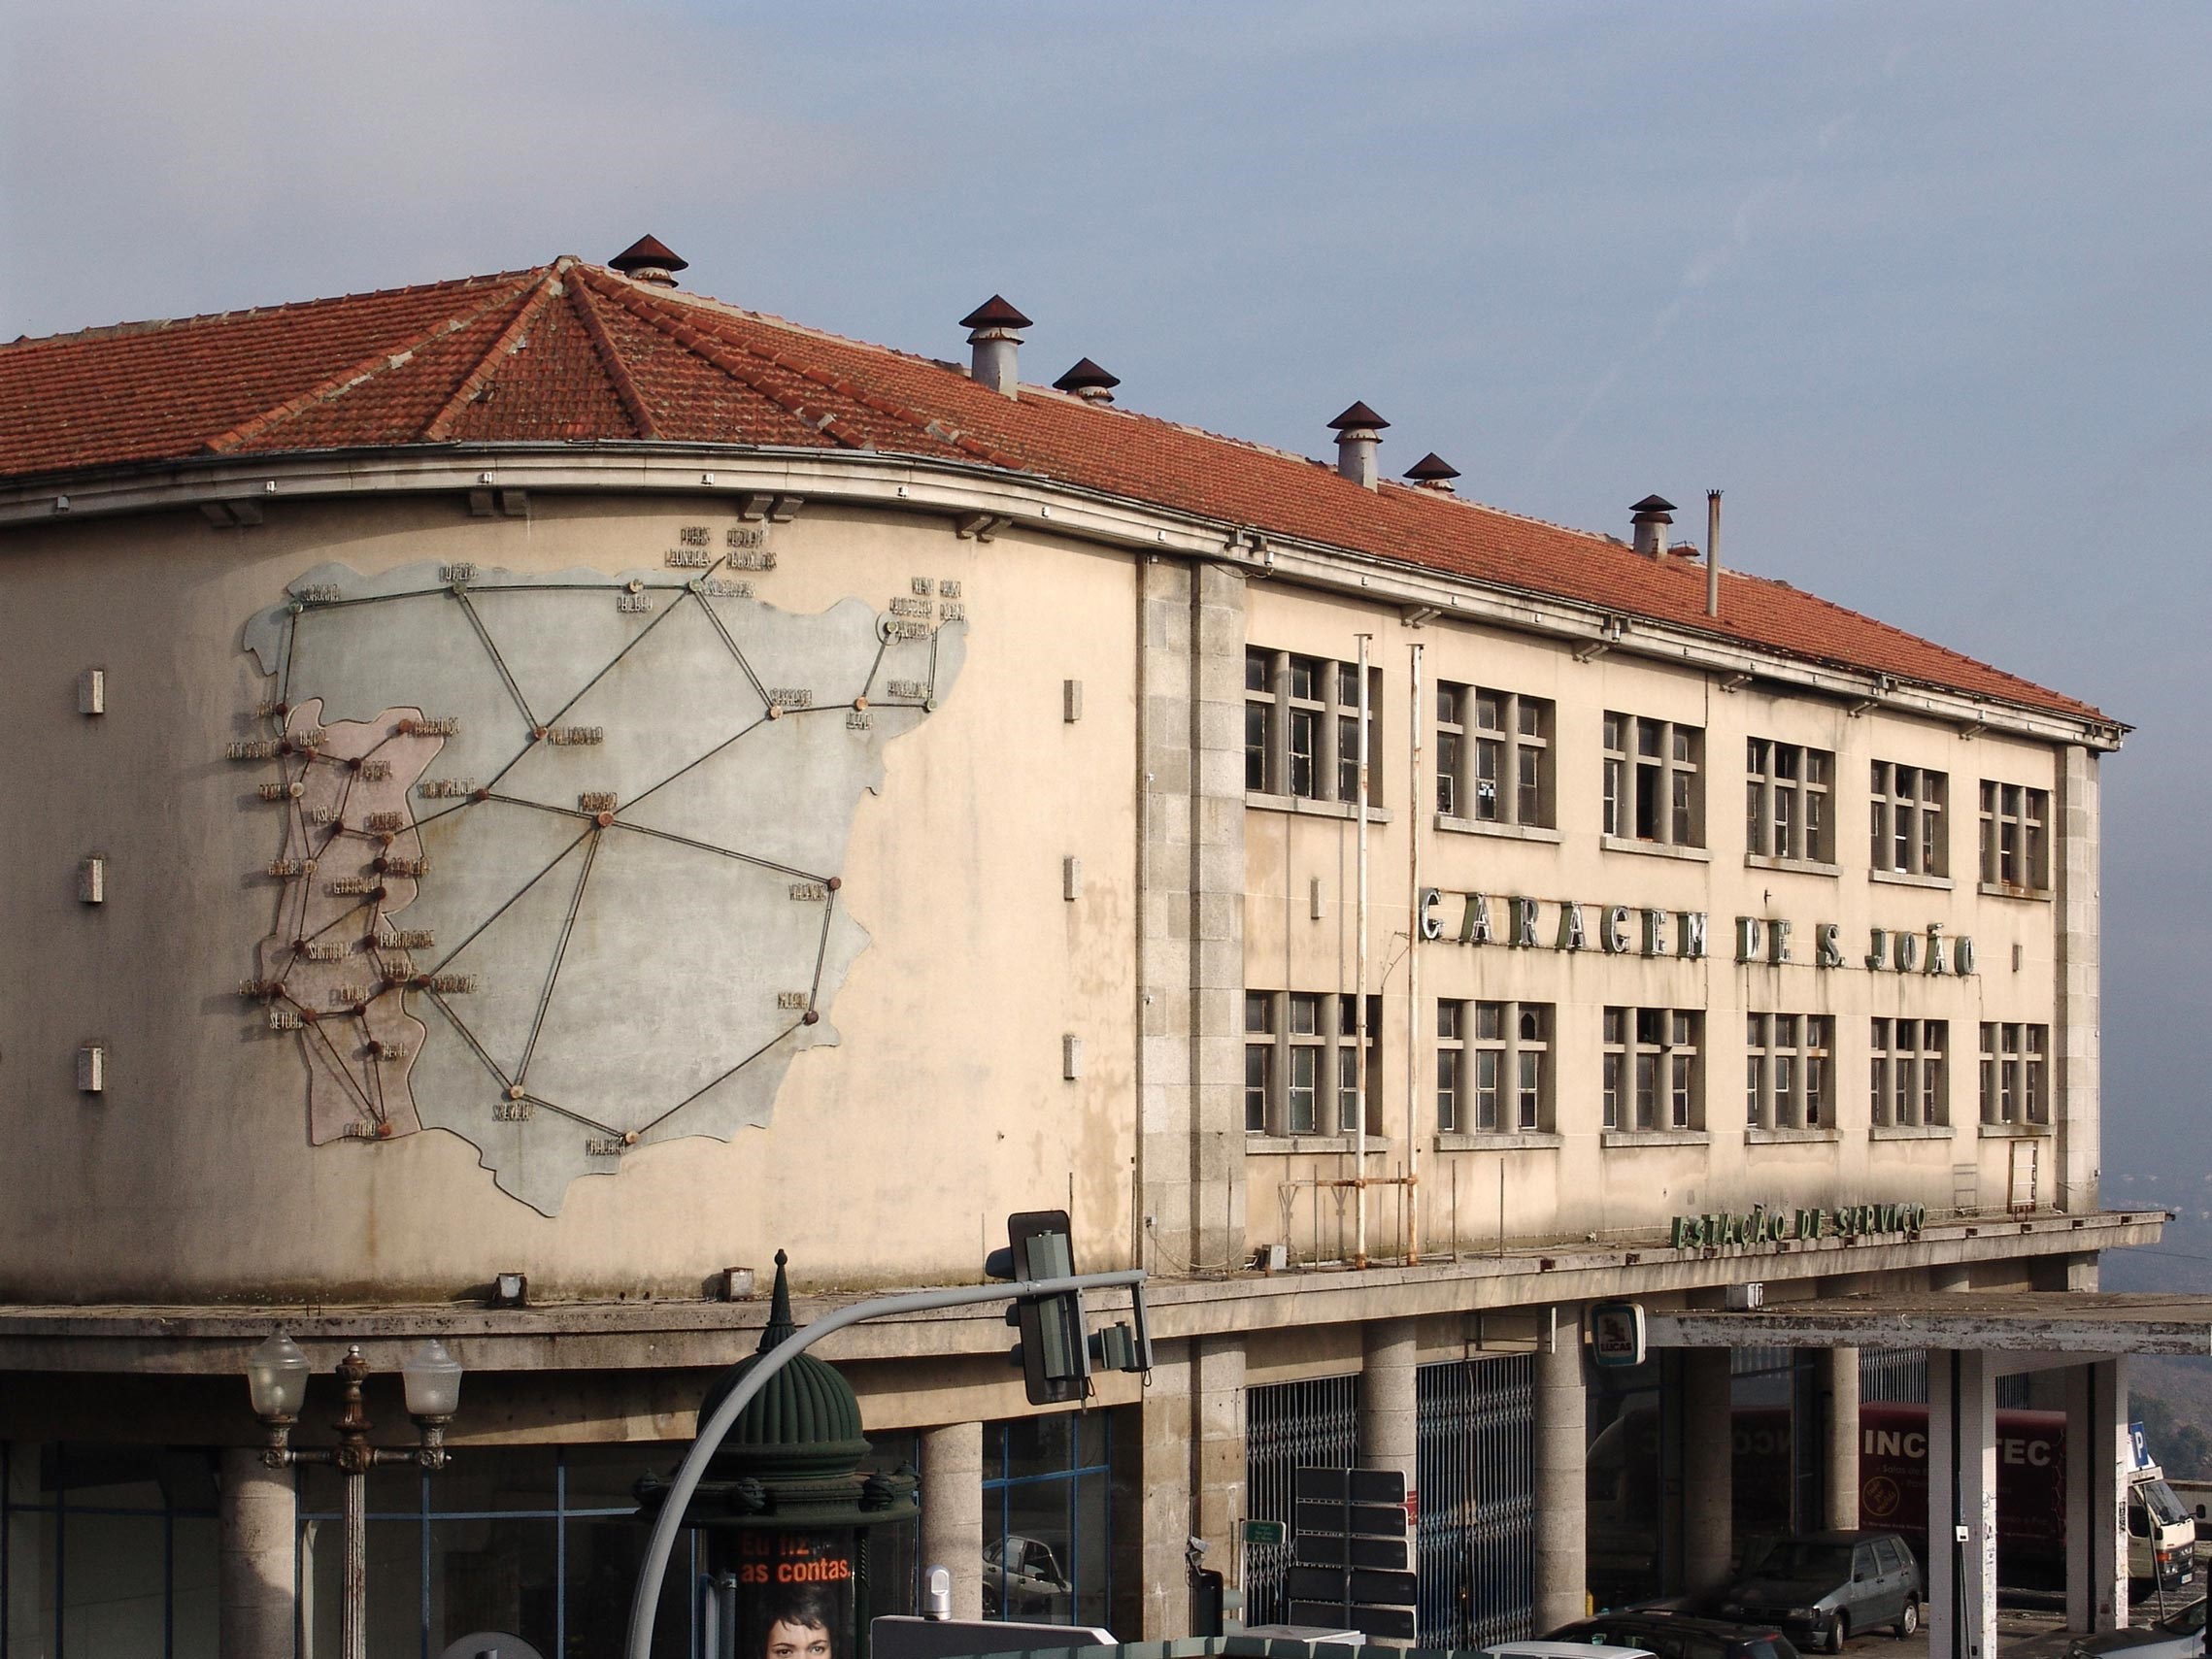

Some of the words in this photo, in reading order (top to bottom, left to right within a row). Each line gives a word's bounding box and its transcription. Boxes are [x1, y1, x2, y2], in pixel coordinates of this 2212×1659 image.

[1420, 887, 1708, 959] GARAGEM
[1735, 915, 1792, 965] DE
[1864, 922, 1975, 975] JOÃO
[1671, 1203, 1786, 1250] ESTAÇÃO
[1795, 1208, 1827, 1240] DE
[1833, 1203, 1927, 1238] SERVIÇO
[2134, 1431, 2144, 1458] P
[740, 1563, 770, 1584] as
